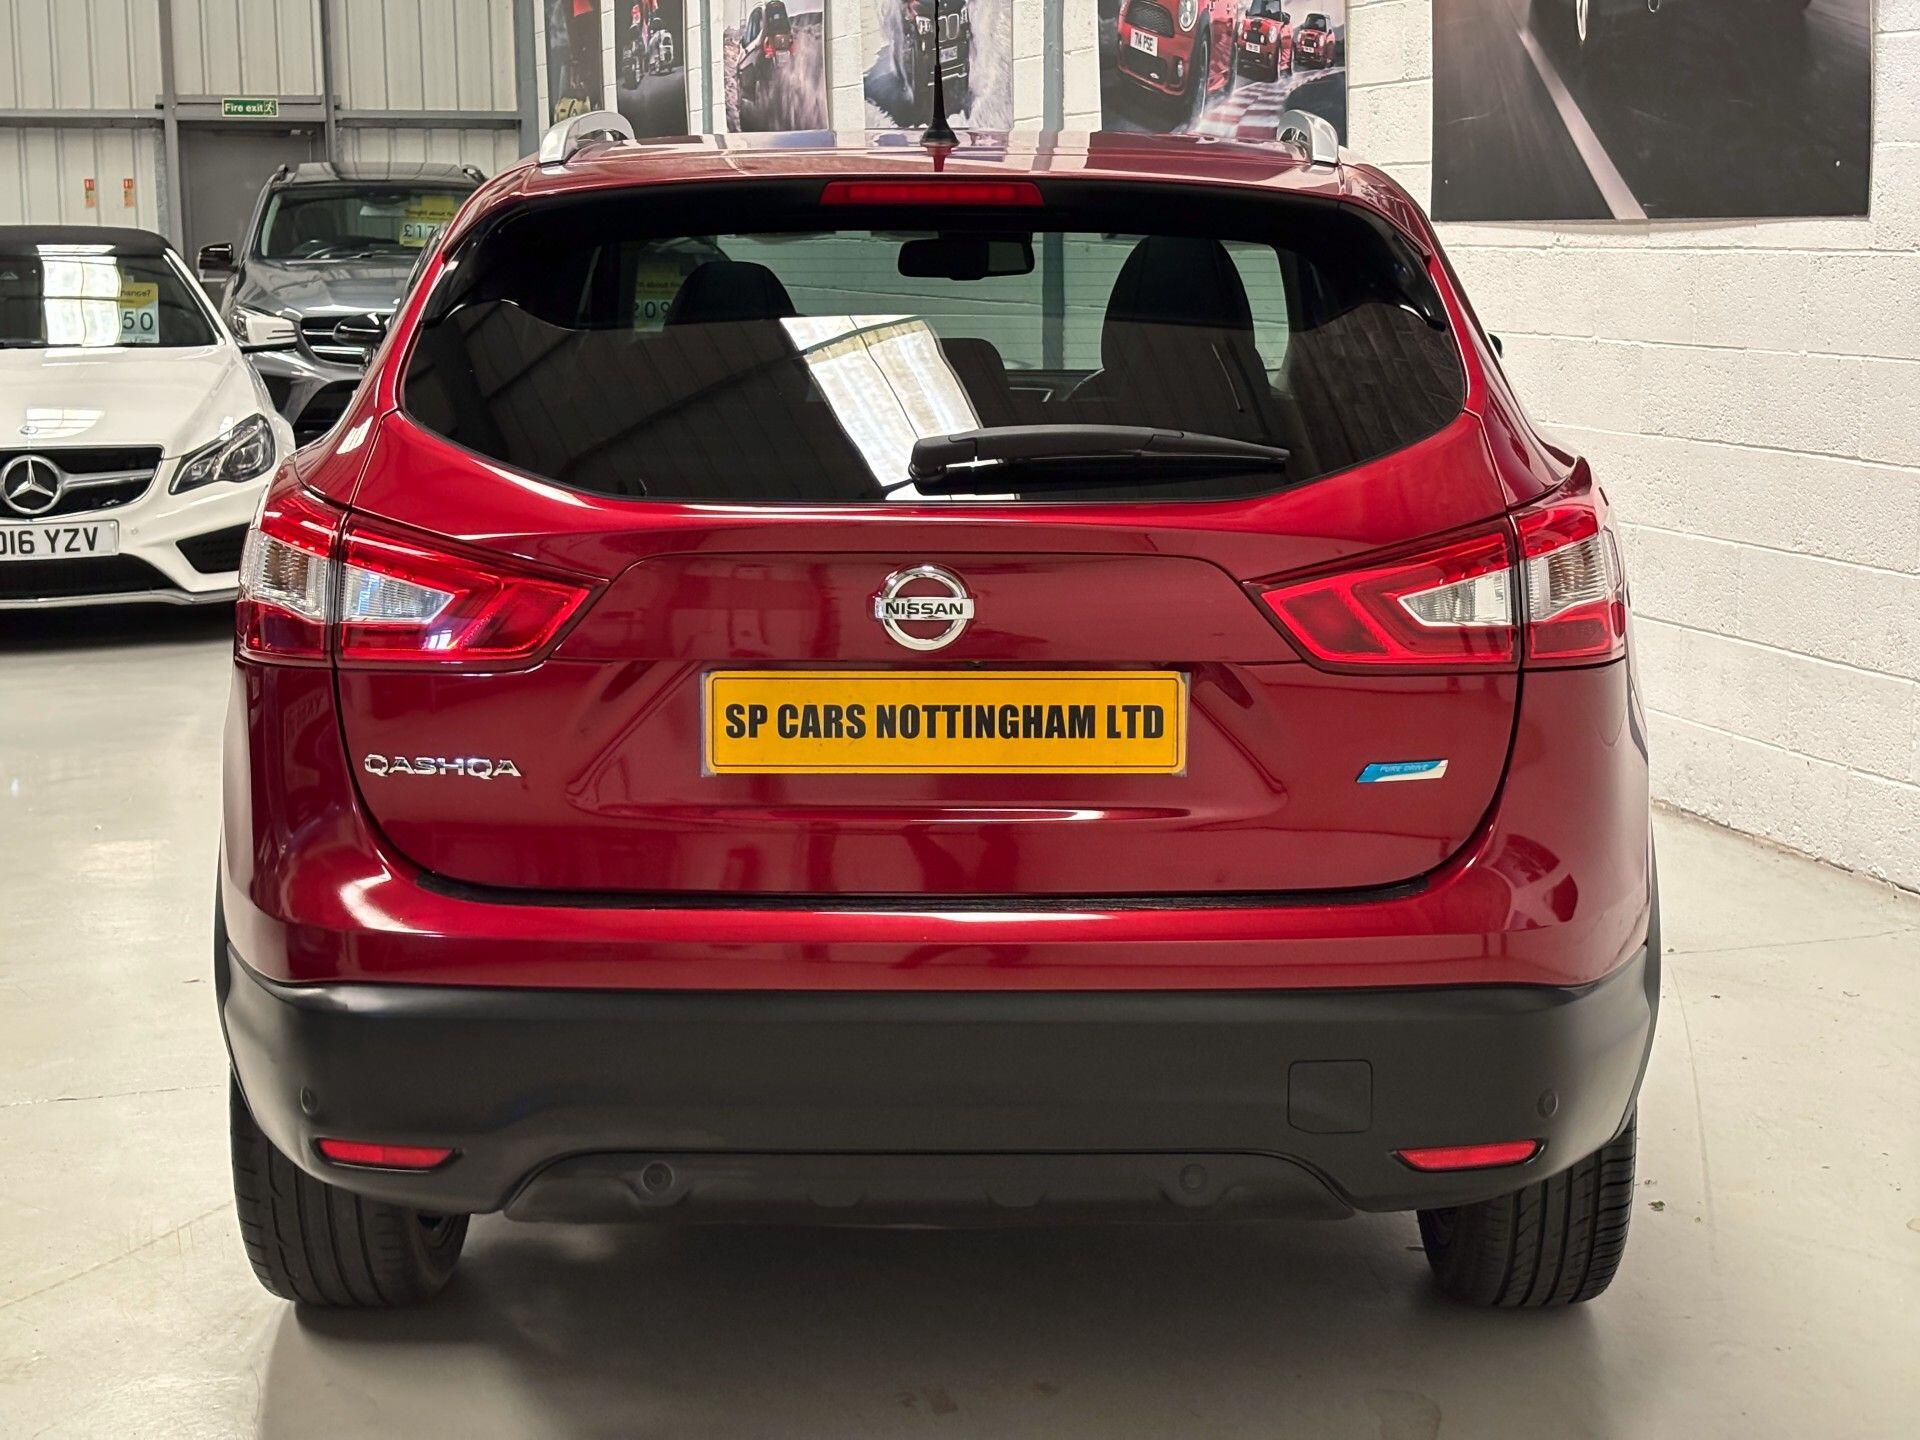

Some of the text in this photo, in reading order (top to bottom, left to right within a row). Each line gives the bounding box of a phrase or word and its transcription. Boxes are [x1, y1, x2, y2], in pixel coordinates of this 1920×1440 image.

[225, 103, 263, 112] Fire exit
[44, 527, 98, 553] YZV
[885, 602, 963, 615] NISSAN
[725, 703, 1164, 738] SP CARS NOTTINGHAM LTD
[364, 753, 522, 780] QASHQA
